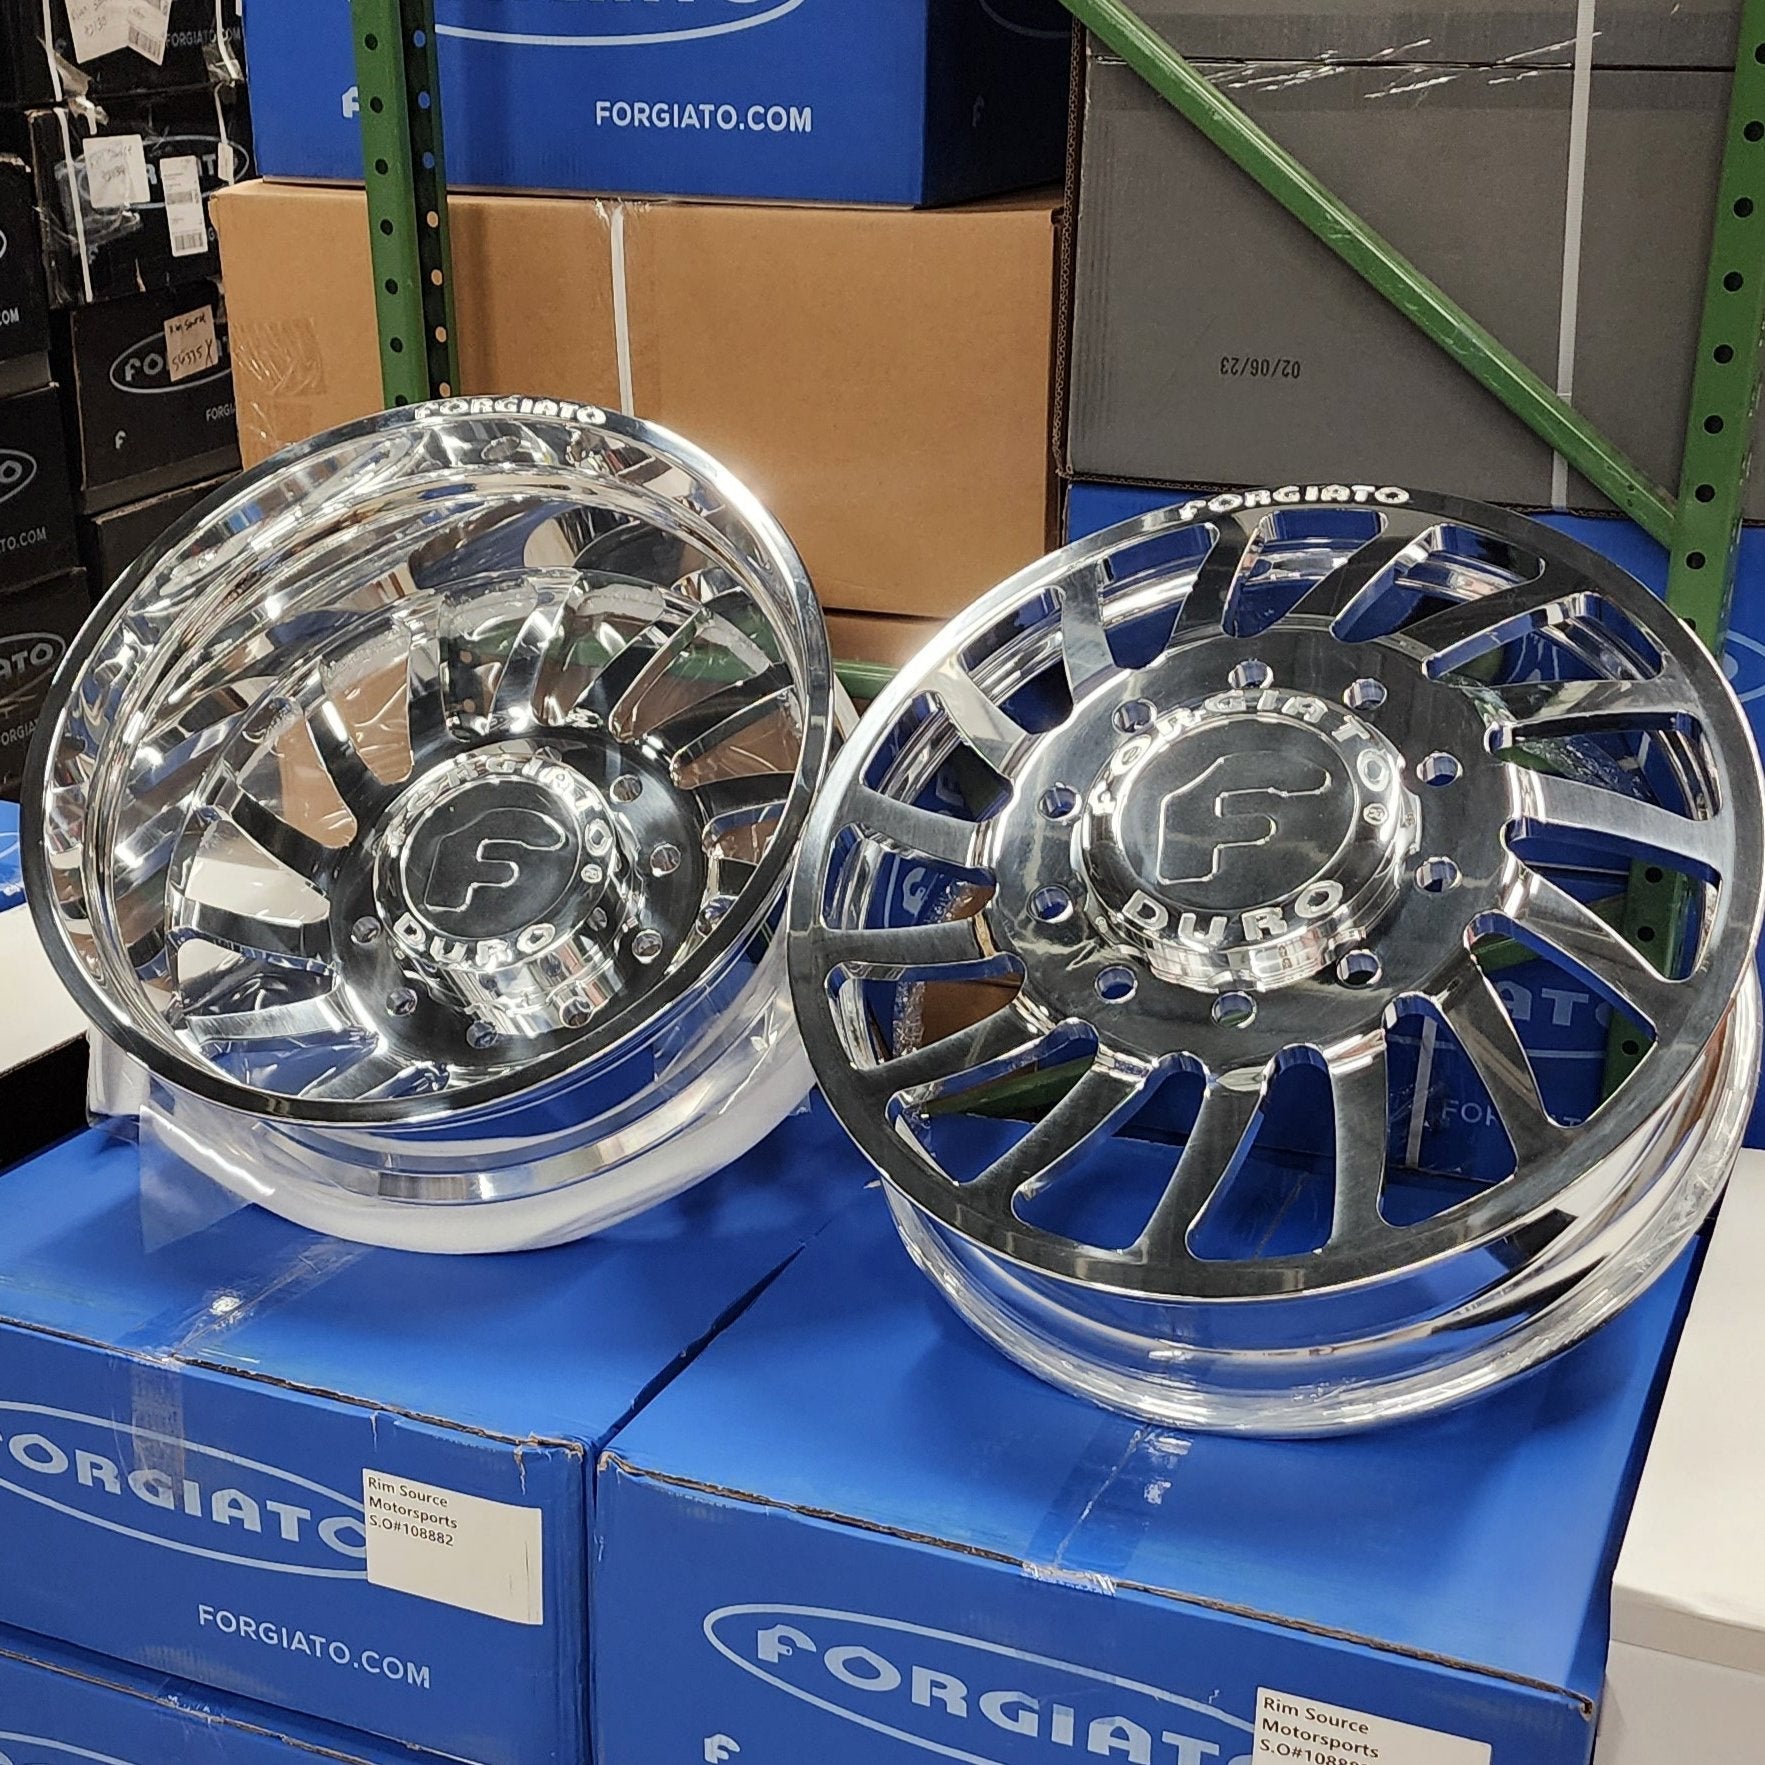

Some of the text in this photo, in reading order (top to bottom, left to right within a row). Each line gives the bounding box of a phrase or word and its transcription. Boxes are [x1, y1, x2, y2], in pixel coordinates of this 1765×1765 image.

[595, 101, 812, 132] FORGIATO.COM
[1220, 356, 1301, 379] 02/06/23
[414, 395, 607, 425] FORGIATO
[1178, 484, 1411, 521] FORGIATO
[1087, 688, 1391, 816] FORGIATO
[1121, 879, 1344, 953] DURO
[393, 911, 556, 971] DURO
[0, 1432, 368, 1559] ORGIATO
[368, 1476, 448, 1507] Rim Source
[369, 1496, 458, 1529] Motorsports
[369, 1515, 454, 1547] S.O#108882
[198, 1604, 431, 1689] FORGIATO.COM
[757, 1624, 1257, 1765] FORGIAT
[1263, 1696, 1369, 1734] Rim Source
[1262, 1717, 1379, 1759] Motorsports
